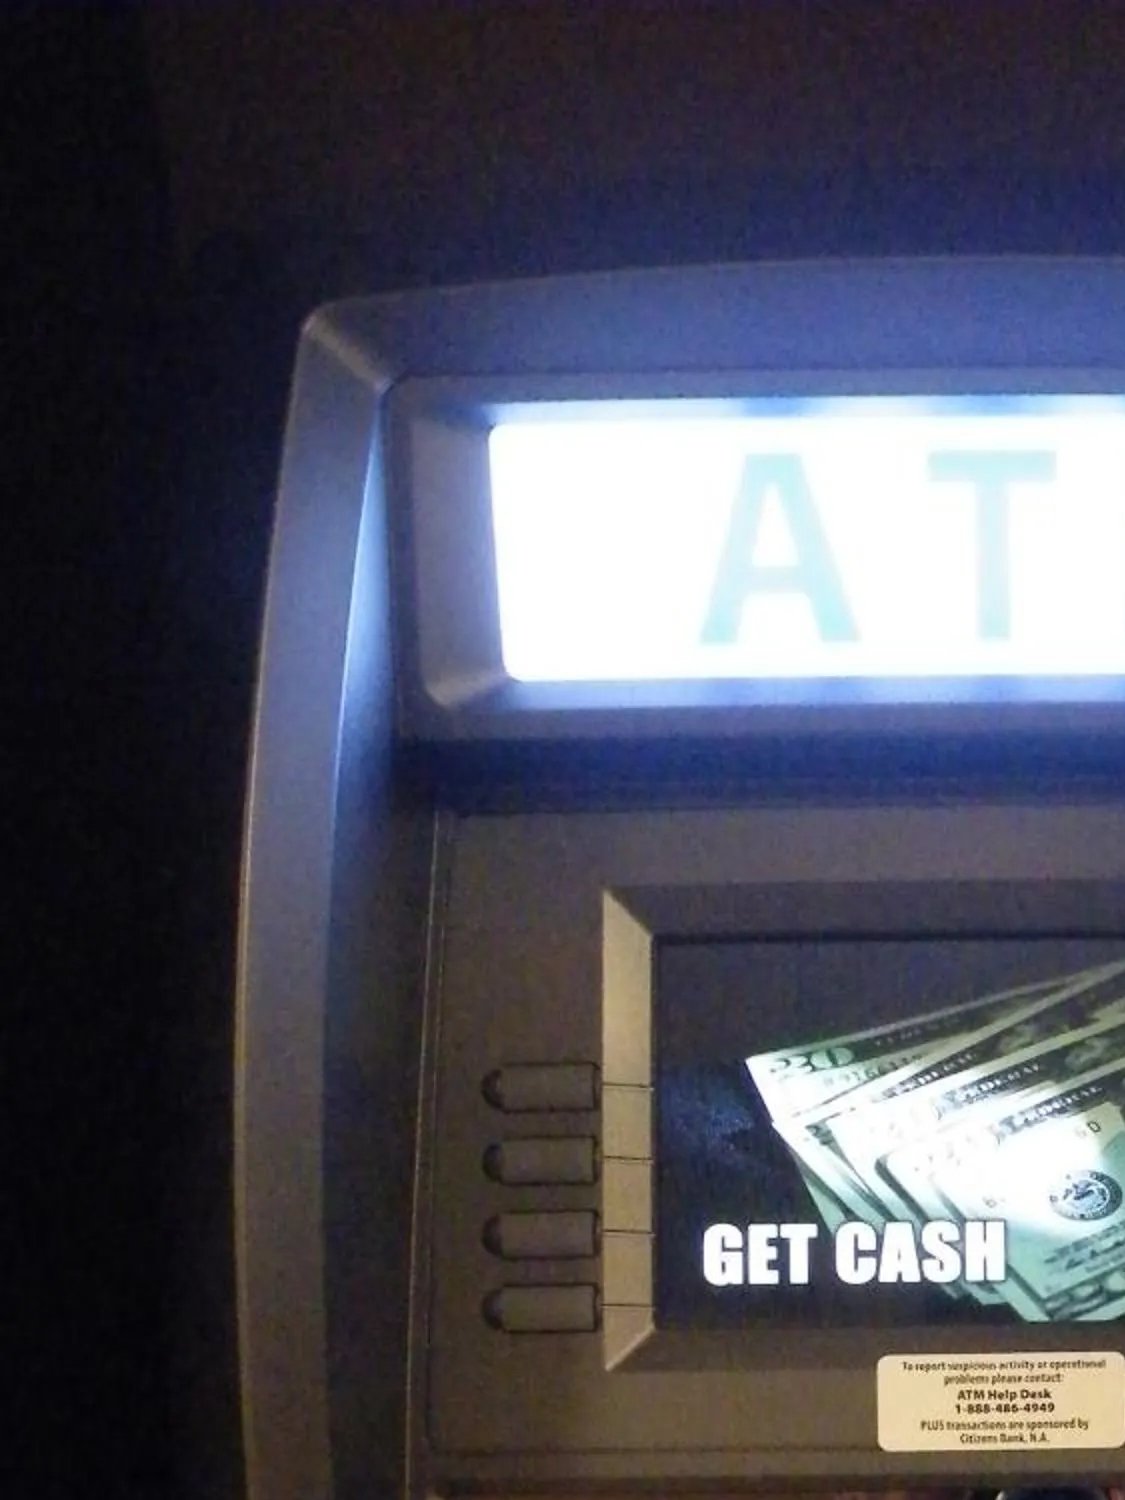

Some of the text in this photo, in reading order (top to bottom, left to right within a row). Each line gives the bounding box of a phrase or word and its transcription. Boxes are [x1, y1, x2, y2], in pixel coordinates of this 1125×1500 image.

[702, 1223, 817, 1286] GET
[834, 1219, 1007, 1285] CASH
[903, 1361, 914, 1371] To
[915, 1361, 946, 1373] report
[1000, 1359, 1035, 1372] activity
[1050, 1358, 1107, 1371] operational
[944, 1373, 989, 1386] problems
[991, 1373, 1022, 1385] please
[957, 1388, 1053, 1402] ATM Help Desk
[920, 1418, 1089, 1431] PLUS transactions are sponsored by
[959, 1432, 998, 1444] Citizens
